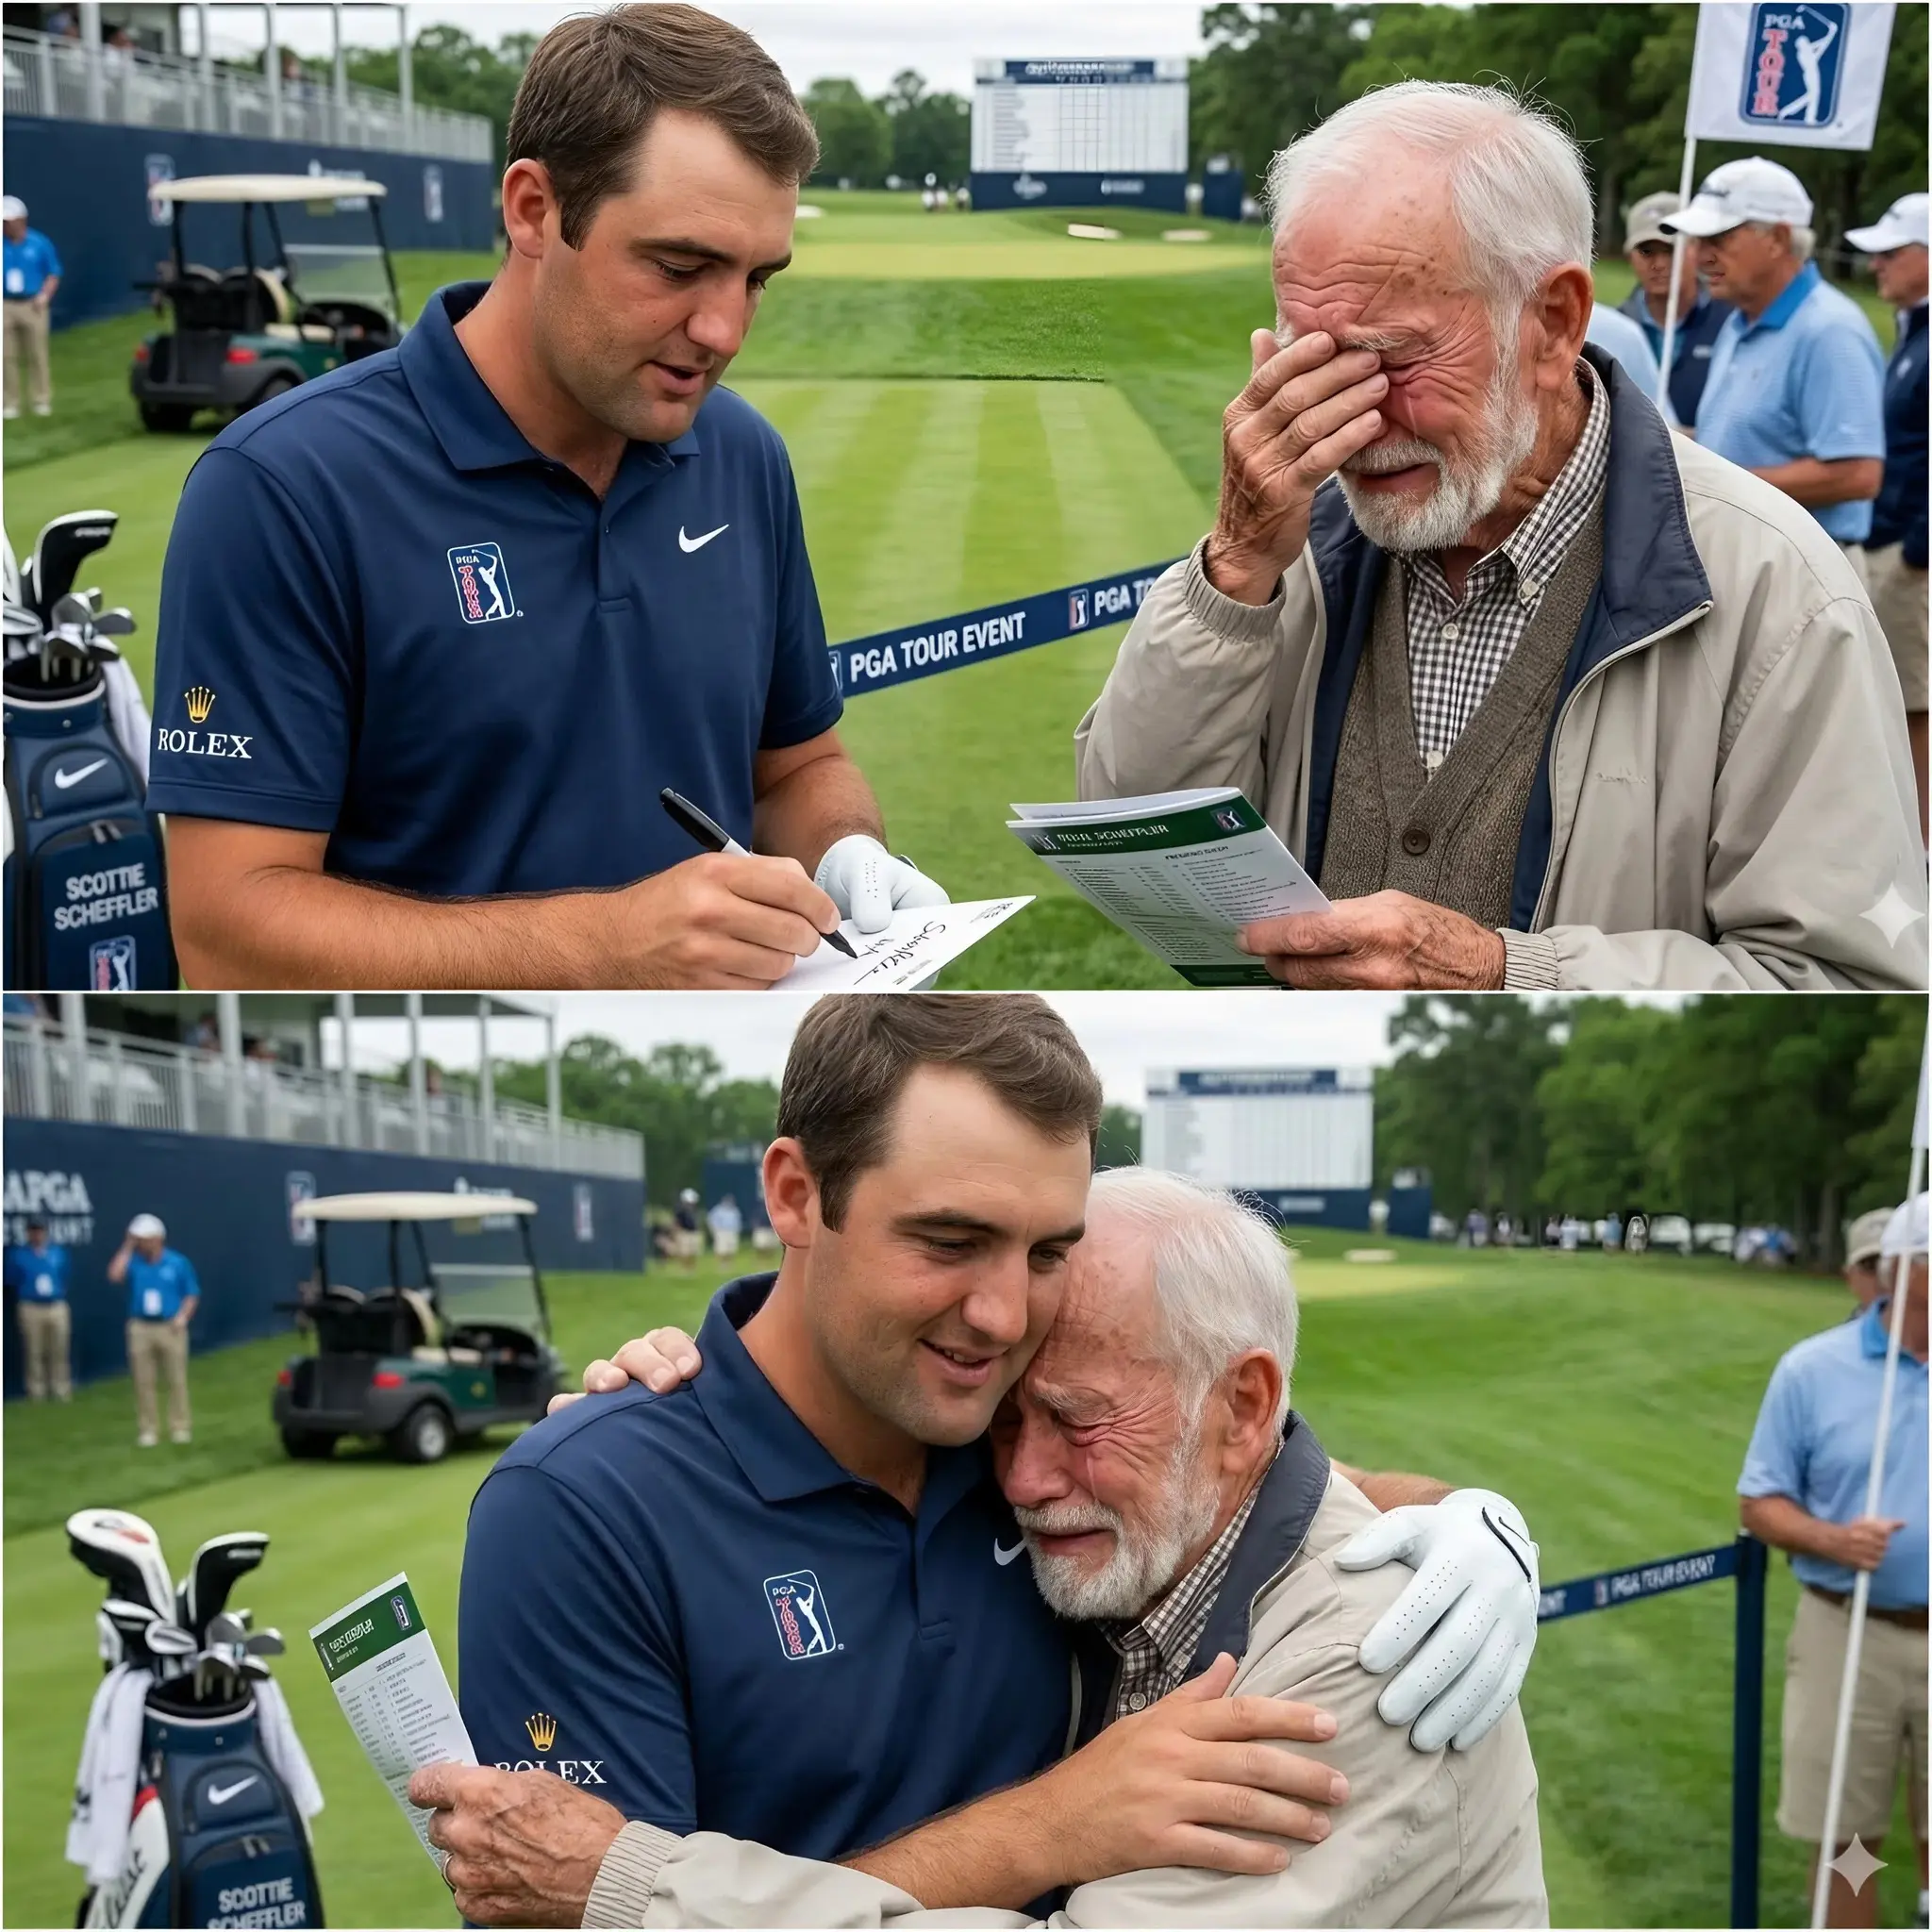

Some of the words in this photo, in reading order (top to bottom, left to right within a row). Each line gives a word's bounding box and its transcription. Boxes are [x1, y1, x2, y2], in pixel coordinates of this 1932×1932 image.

[1763, 13, 1806, 30] PGA
[1751, 28, 1789, 116] TOUR
[1094, 584, 1132, 616] PGA
[850, 644, 898, 683] PGA
[900, 629, 959, 669] TOUR
[962, 611, 1026, 654] EVENT
[158, 728, 253, 759] ROLEX
[65, 862, 146, 901] SCOTTIE
[54, 887, 158, 931] SCHEFFLER
[218, 1876, 294, 1914] SCOTTIE
